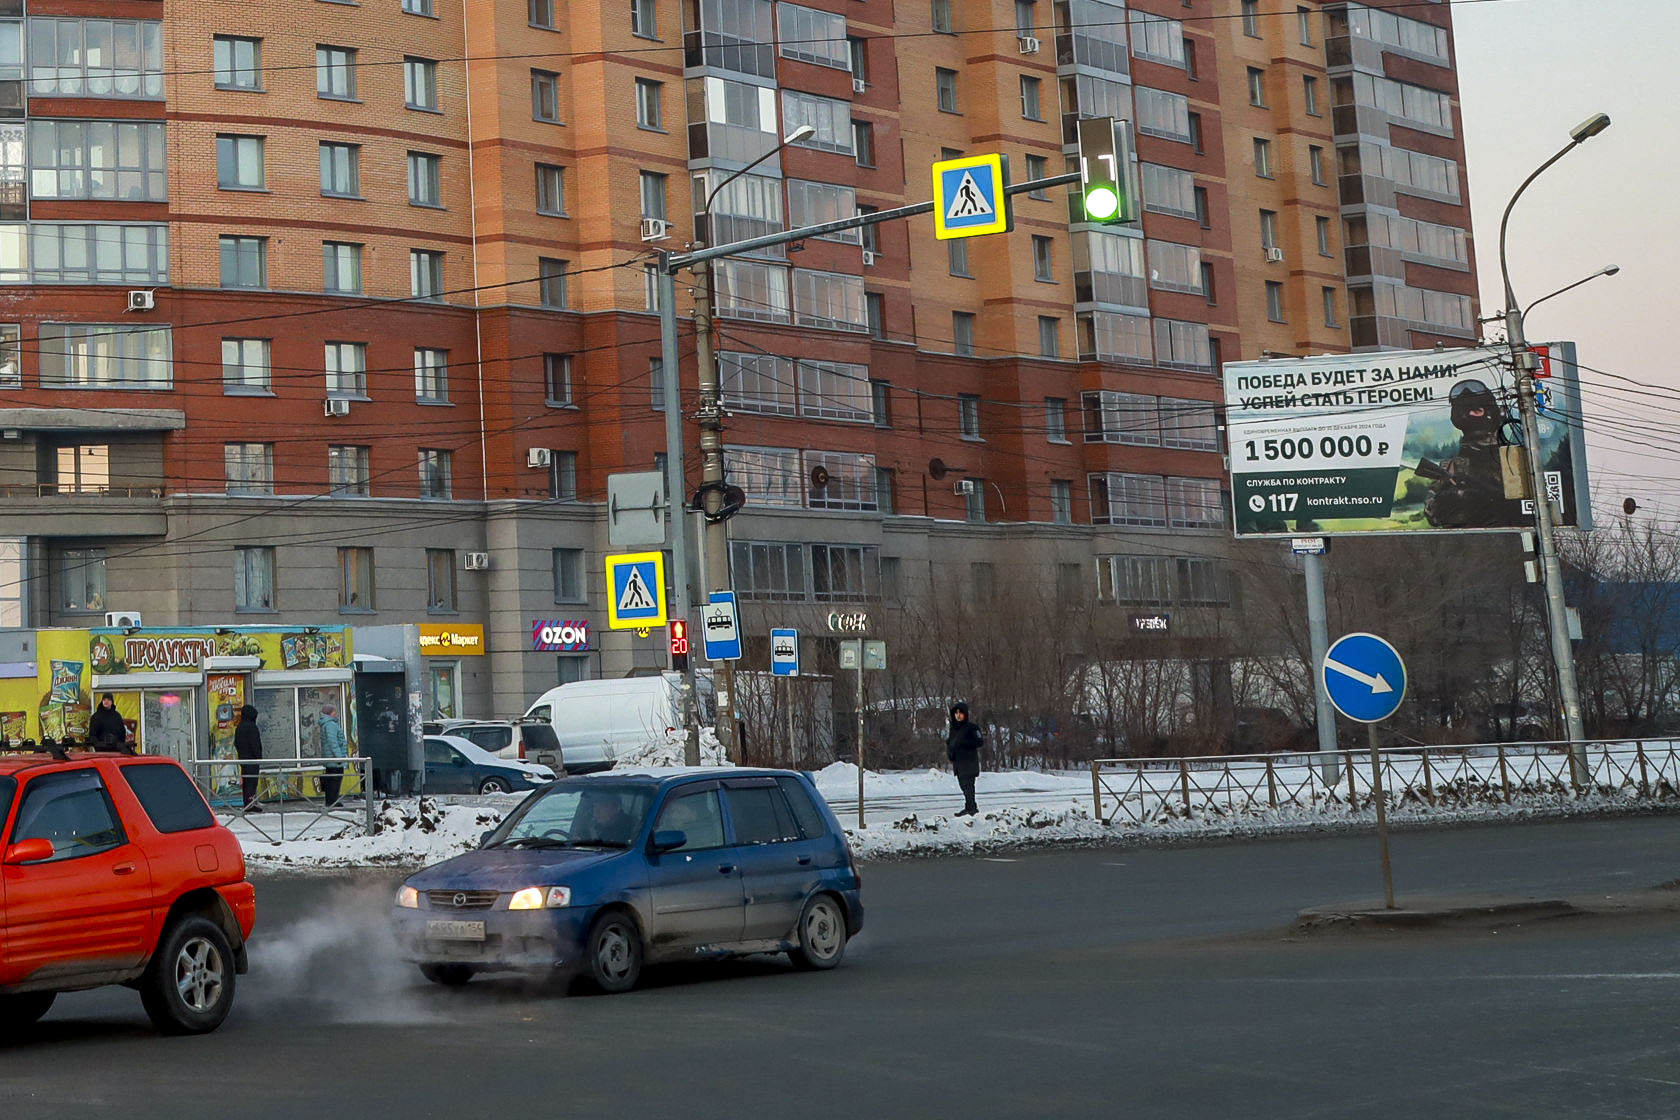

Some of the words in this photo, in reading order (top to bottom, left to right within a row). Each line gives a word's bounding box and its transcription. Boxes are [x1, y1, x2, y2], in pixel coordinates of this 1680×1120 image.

[1237, 373, 1307, 390] ПОБЕДА
[1311, 369, 1366, 387] БУДЕТ
[1372, 368, 1394, 381] ЗА
[1399, 364, 1458, 380] НАМИ!
[1240, 390, 1297, 410] УСПЕЙ
[1300, 391, 1354, 408] СТАТЬ
[1358, 387, 1433, 404] ГЕРОЕМ!
[1264, 438, 1314, 460] 500
[1320, 435, 1372, 458] 000
[1246, 478, 1281, 487] СЛУЖБА
[1283, 478, 1295, 486] ПО
[1296, 476, 1347, 485] КОНТРАКТУ
[1269, 493, 1299, 512] 117
[1306, 495, 1383, 506] kontrakt.nso.ru
[451, 633, 479, 647] Маркет
[541, 626, 586, 644] OZON
[94, 646, 108, 660] 24
[126, 639, 216, 671] ПРОДУКТЫ
[671, 638, 688, 654] 20
